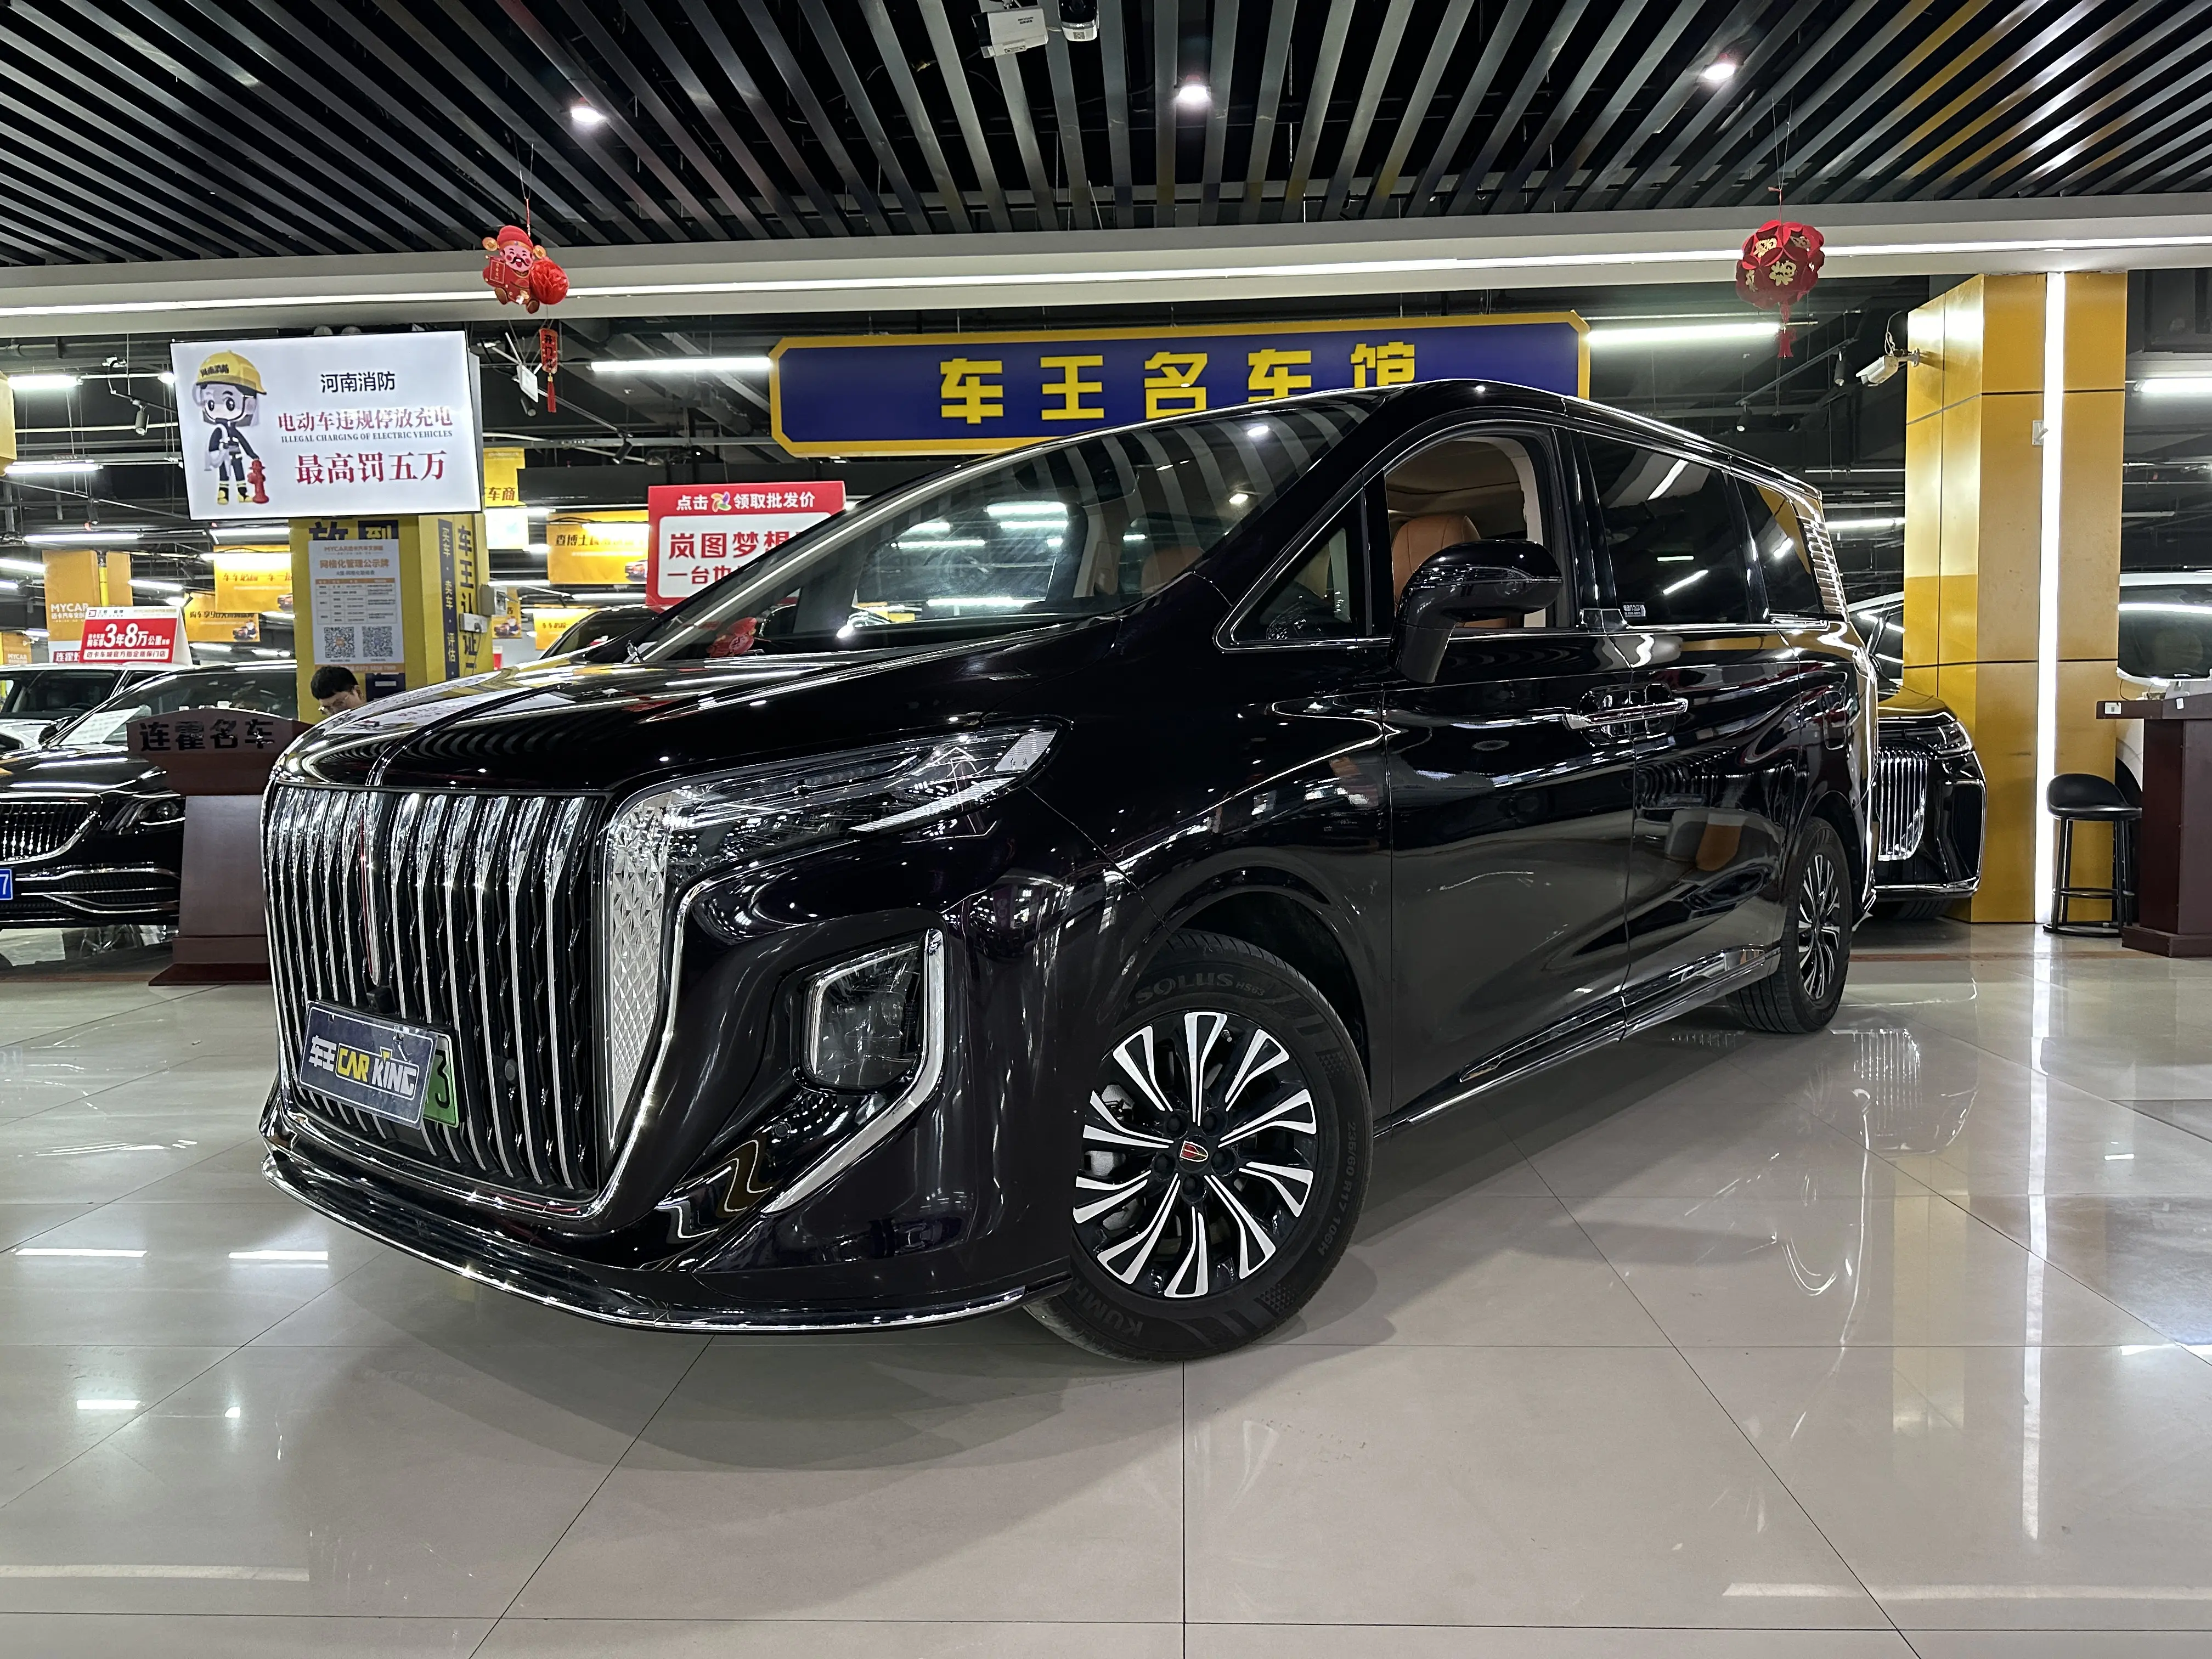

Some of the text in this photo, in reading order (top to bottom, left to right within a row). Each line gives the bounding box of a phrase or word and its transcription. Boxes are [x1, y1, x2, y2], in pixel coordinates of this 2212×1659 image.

[321, 371, 396, 393] 河南消防
[939, 341, 1415, 424] 车王名车馆
[278, 407, 453, 432] 电动车违规停放充电
[316, 434, 358, 442] CHARGING
[413, 430, 453, 438] VEHICLES
[295, 450, 447, 484] 最高罚五万
[484, 487, 516, 500] 车商
[676, 491, 815, 511] 点击 领取批发价
[669, 531, 800, 560] 岚图梦想
[667, 565, 742, 585] 一台也
[442, 527, 455, 663] 买车 卖车 评估
[104, 623, 162, 647] 3年8万公里
[139, 719, 274, 751] 连霍名车
[1135, 973, 1234, 1004] SOLUS
[337, 1047, 370, 1082] CAR
[371, 1048, 417, 1096] KING
[1317, 1121, 1362, 1256] 235/60 R17 106H
